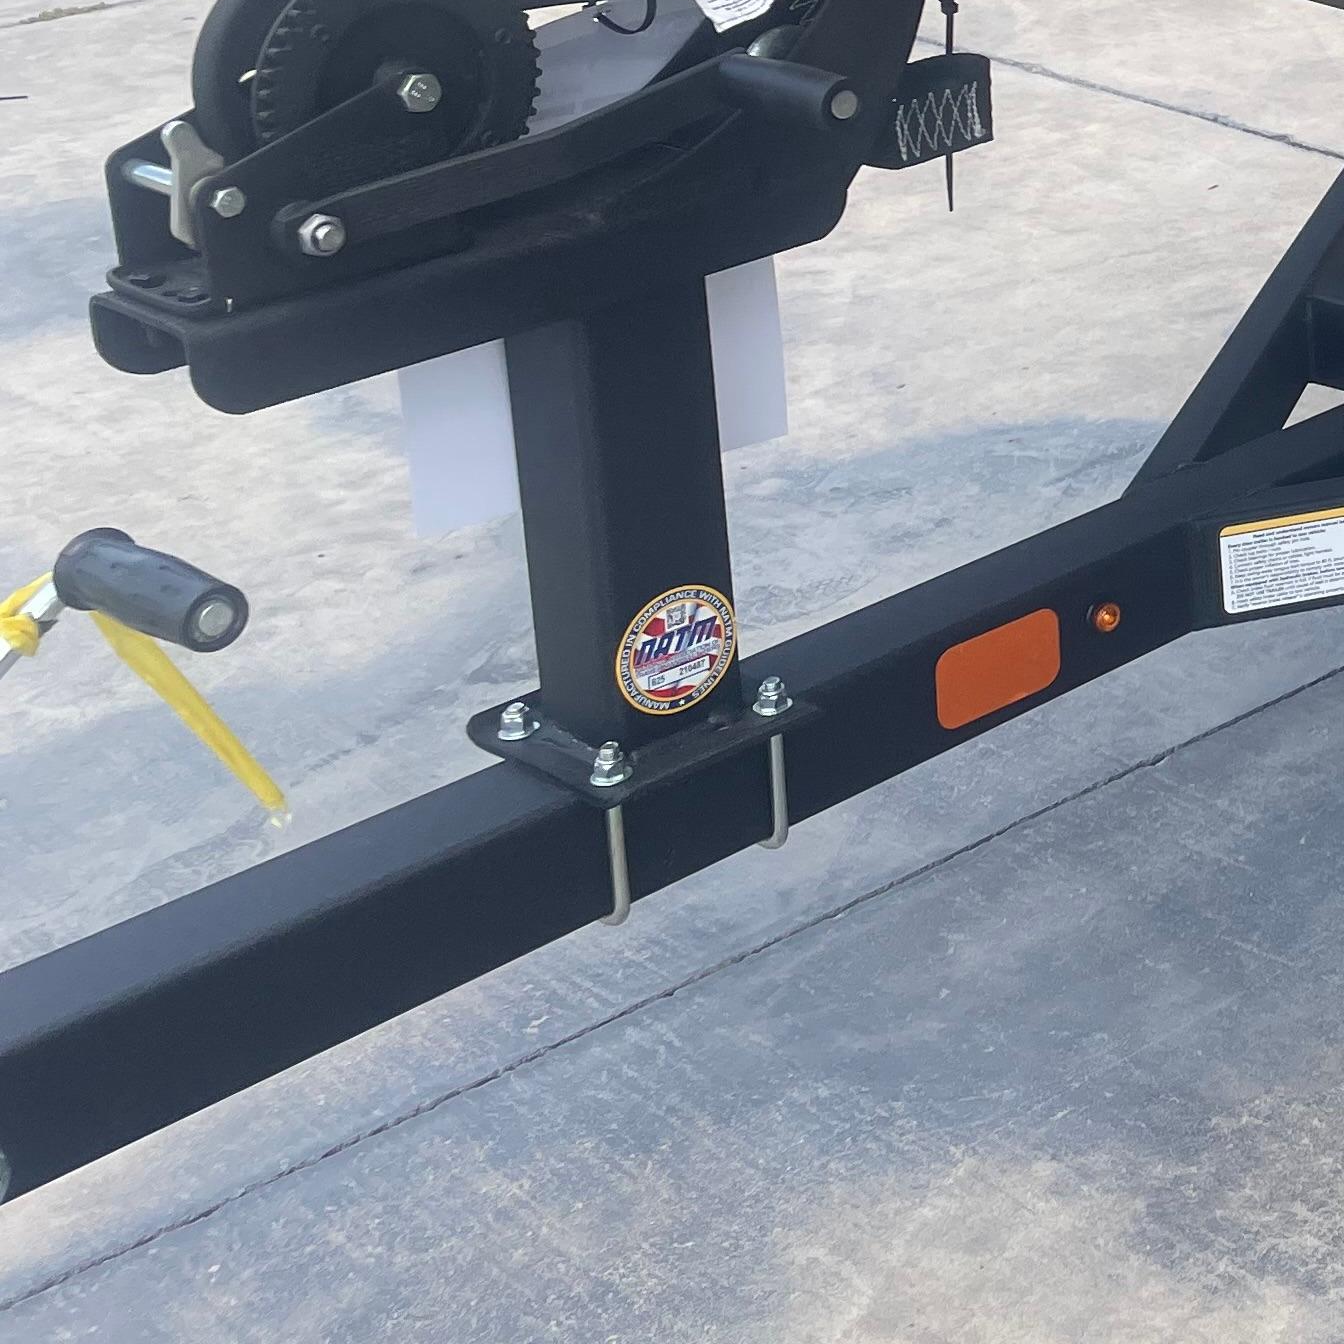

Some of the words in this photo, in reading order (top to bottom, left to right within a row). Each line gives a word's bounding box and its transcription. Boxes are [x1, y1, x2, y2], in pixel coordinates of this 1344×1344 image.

[633, 589, 697, 633] COMPLIANCE
[699, 591, 722, 608] WITH
[719, 606, 733, 637] NATM
[624, 634, 636, 647] IN
[635, 615, 718, 666] NATM
[620, 649, 670, 711] MANUFACTURED
[691, 639, 733, 699] GUIDELINES
